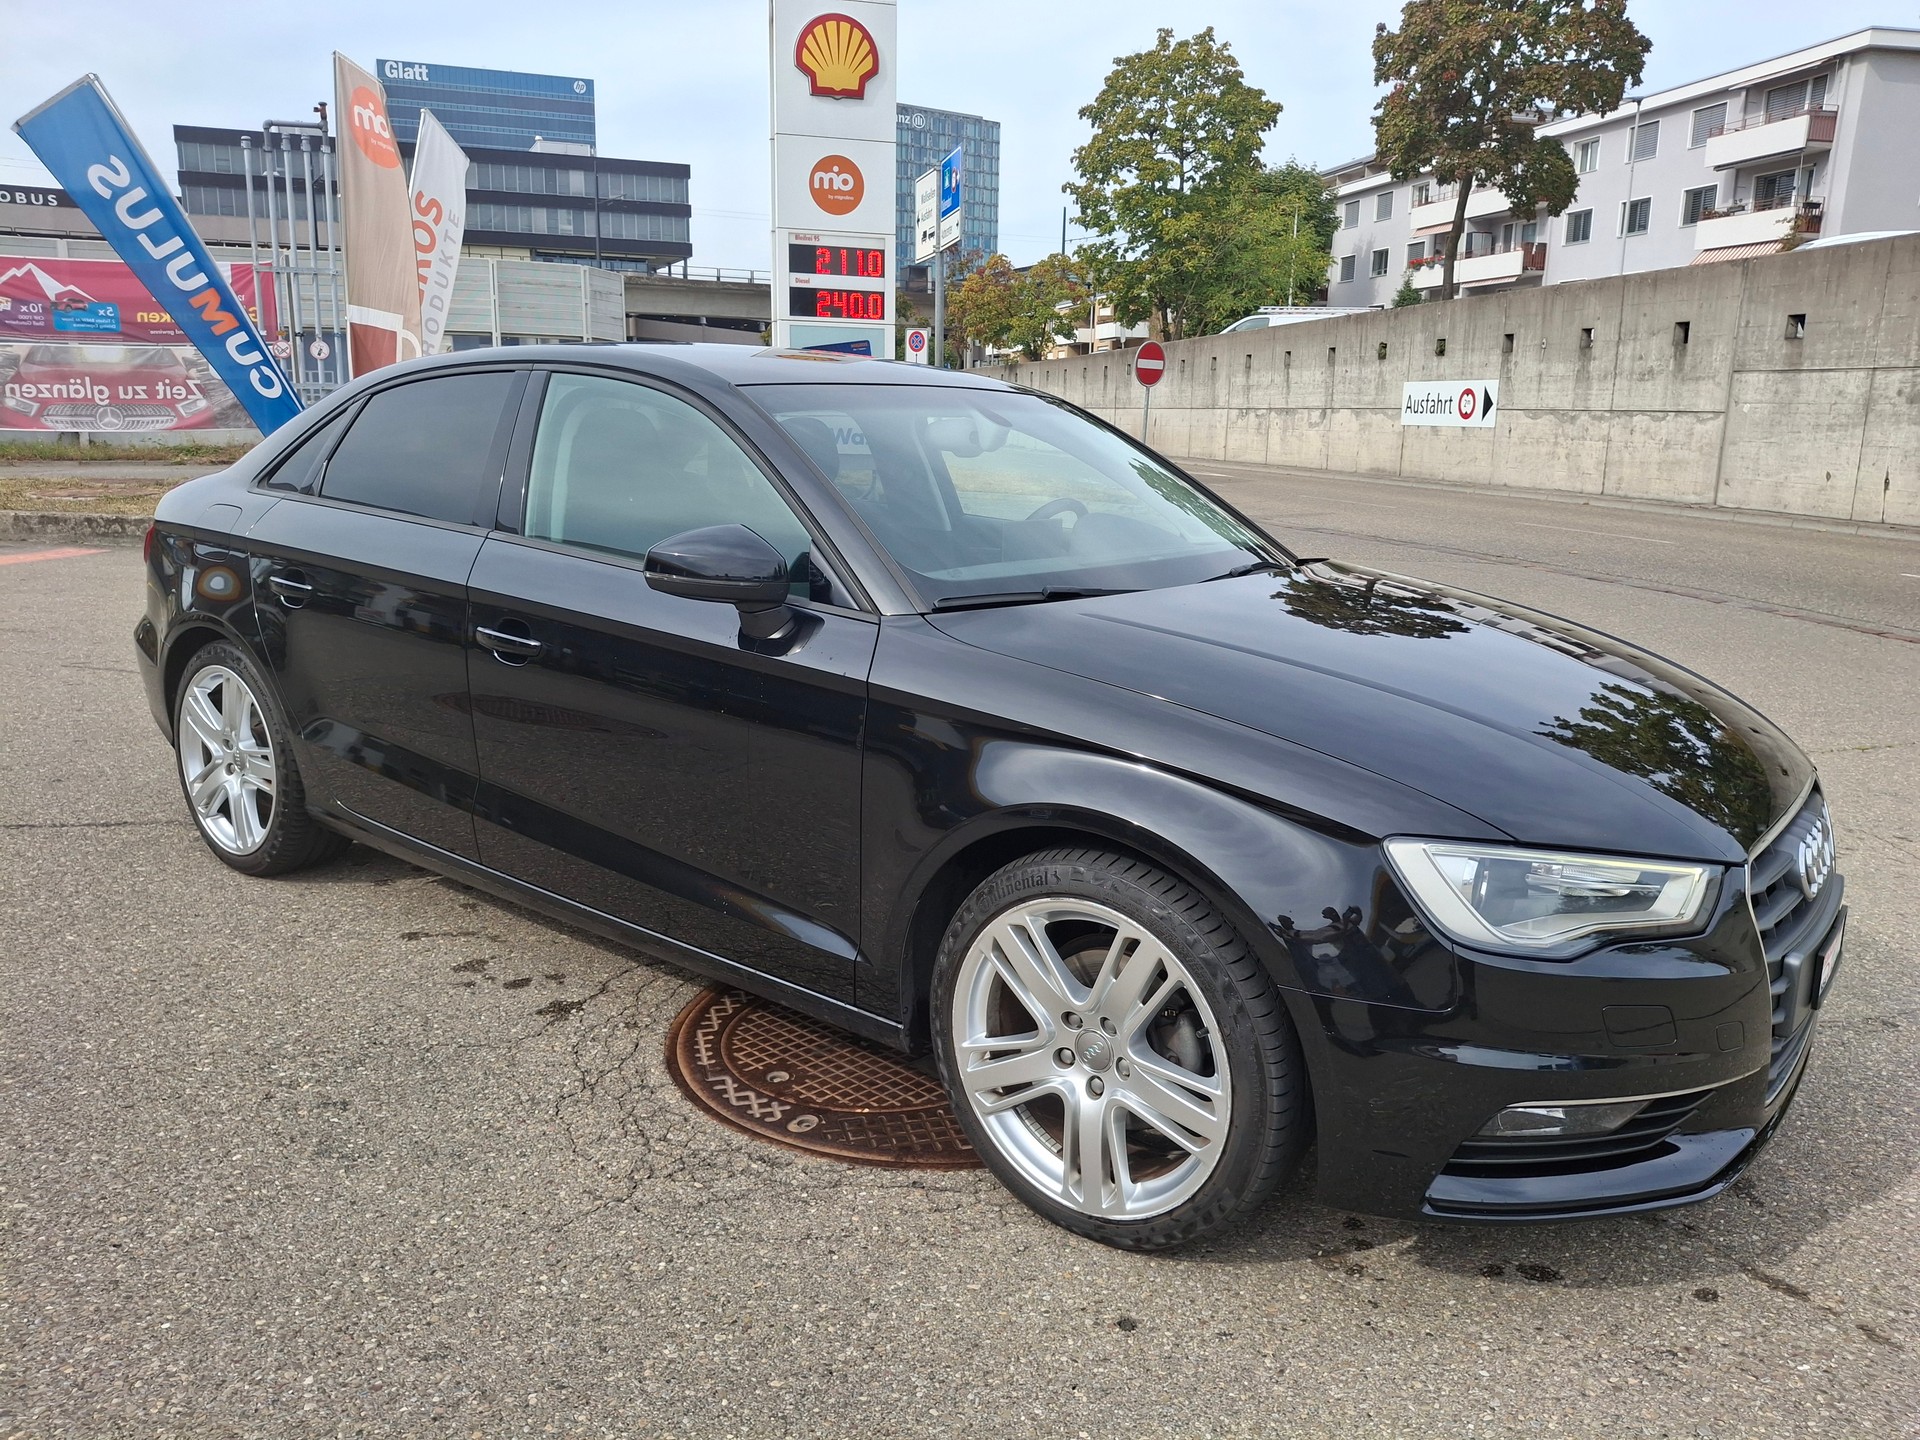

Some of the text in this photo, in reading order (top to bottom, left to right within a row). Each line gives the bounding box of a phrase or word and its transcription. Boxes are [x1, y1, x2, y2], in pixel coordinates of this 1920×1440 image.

[384, 60, 429, 81] Glatt
[574, 81, 586, 93] hp
[354, 102, 390, 138] mio
[814, 165, 854, 191] mio
[795, 234, 812, 242] Bleifrei
[816, 247, 882, 277] 211.0
[423, 209, 460, 356] RODUKTE
[816, 291, 882, 319] 240.0
[1405, 392, 1453, 414] Ausfahrt
[832, 427, 868, 445] Wa
